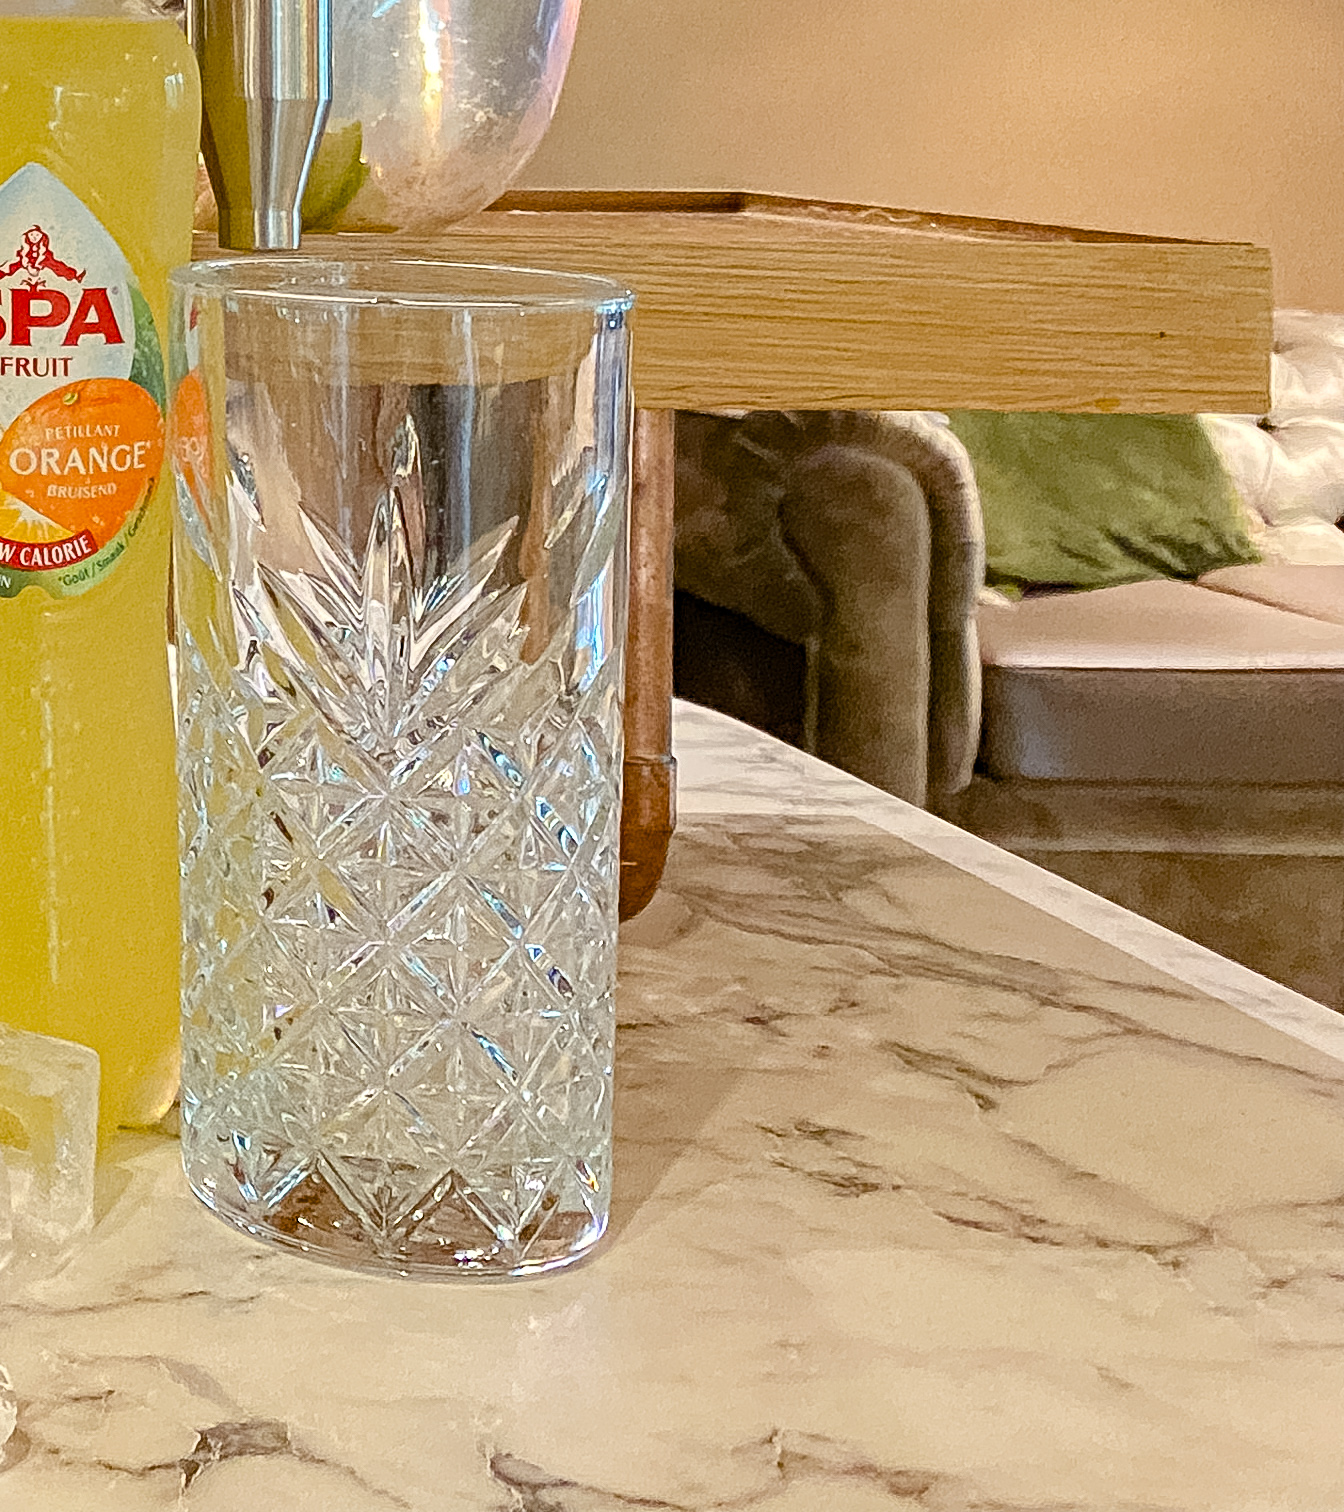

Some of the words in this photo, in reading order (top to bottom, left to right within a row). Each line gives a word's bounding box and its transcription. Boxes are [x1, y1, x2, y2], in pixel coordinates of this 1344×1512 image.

[0, 356, 73, 377] FRUIT
[45, 424, 121, 440] PETILLANT
[9, 440, 147, 476] ORANGE
[47, 483, 117, 499] BRUISEND
[19, 534, 92, 567] CALORIE
